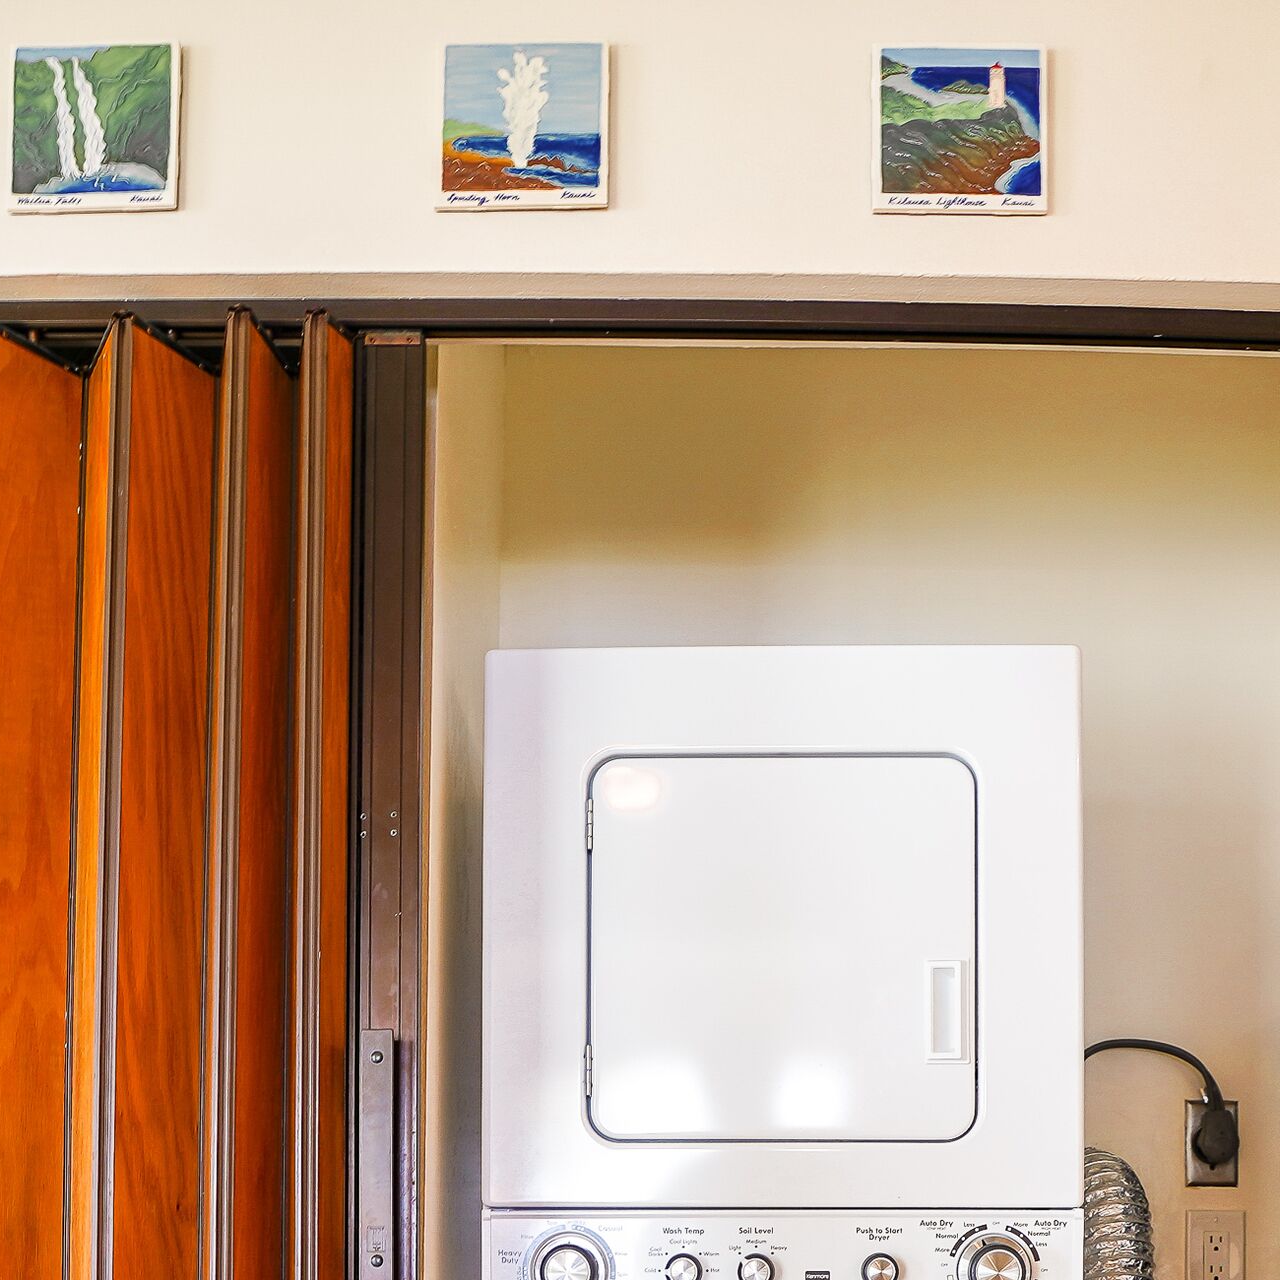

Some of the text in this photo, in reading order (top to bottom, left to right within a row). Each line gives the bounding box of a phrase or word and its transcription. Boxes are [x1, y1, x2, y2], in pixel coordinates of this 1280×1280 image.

[939, 1220, 954, 1228] Dry
[1053, 1220, 1068, 1228] Dry
[663, 1227, 705, 1236] Wash Temp
[868, 1233, 890, 1242] Dryer
[498, 1250, 522, 1258] Heavy
[501, 1257, 519, 1265] Duty
